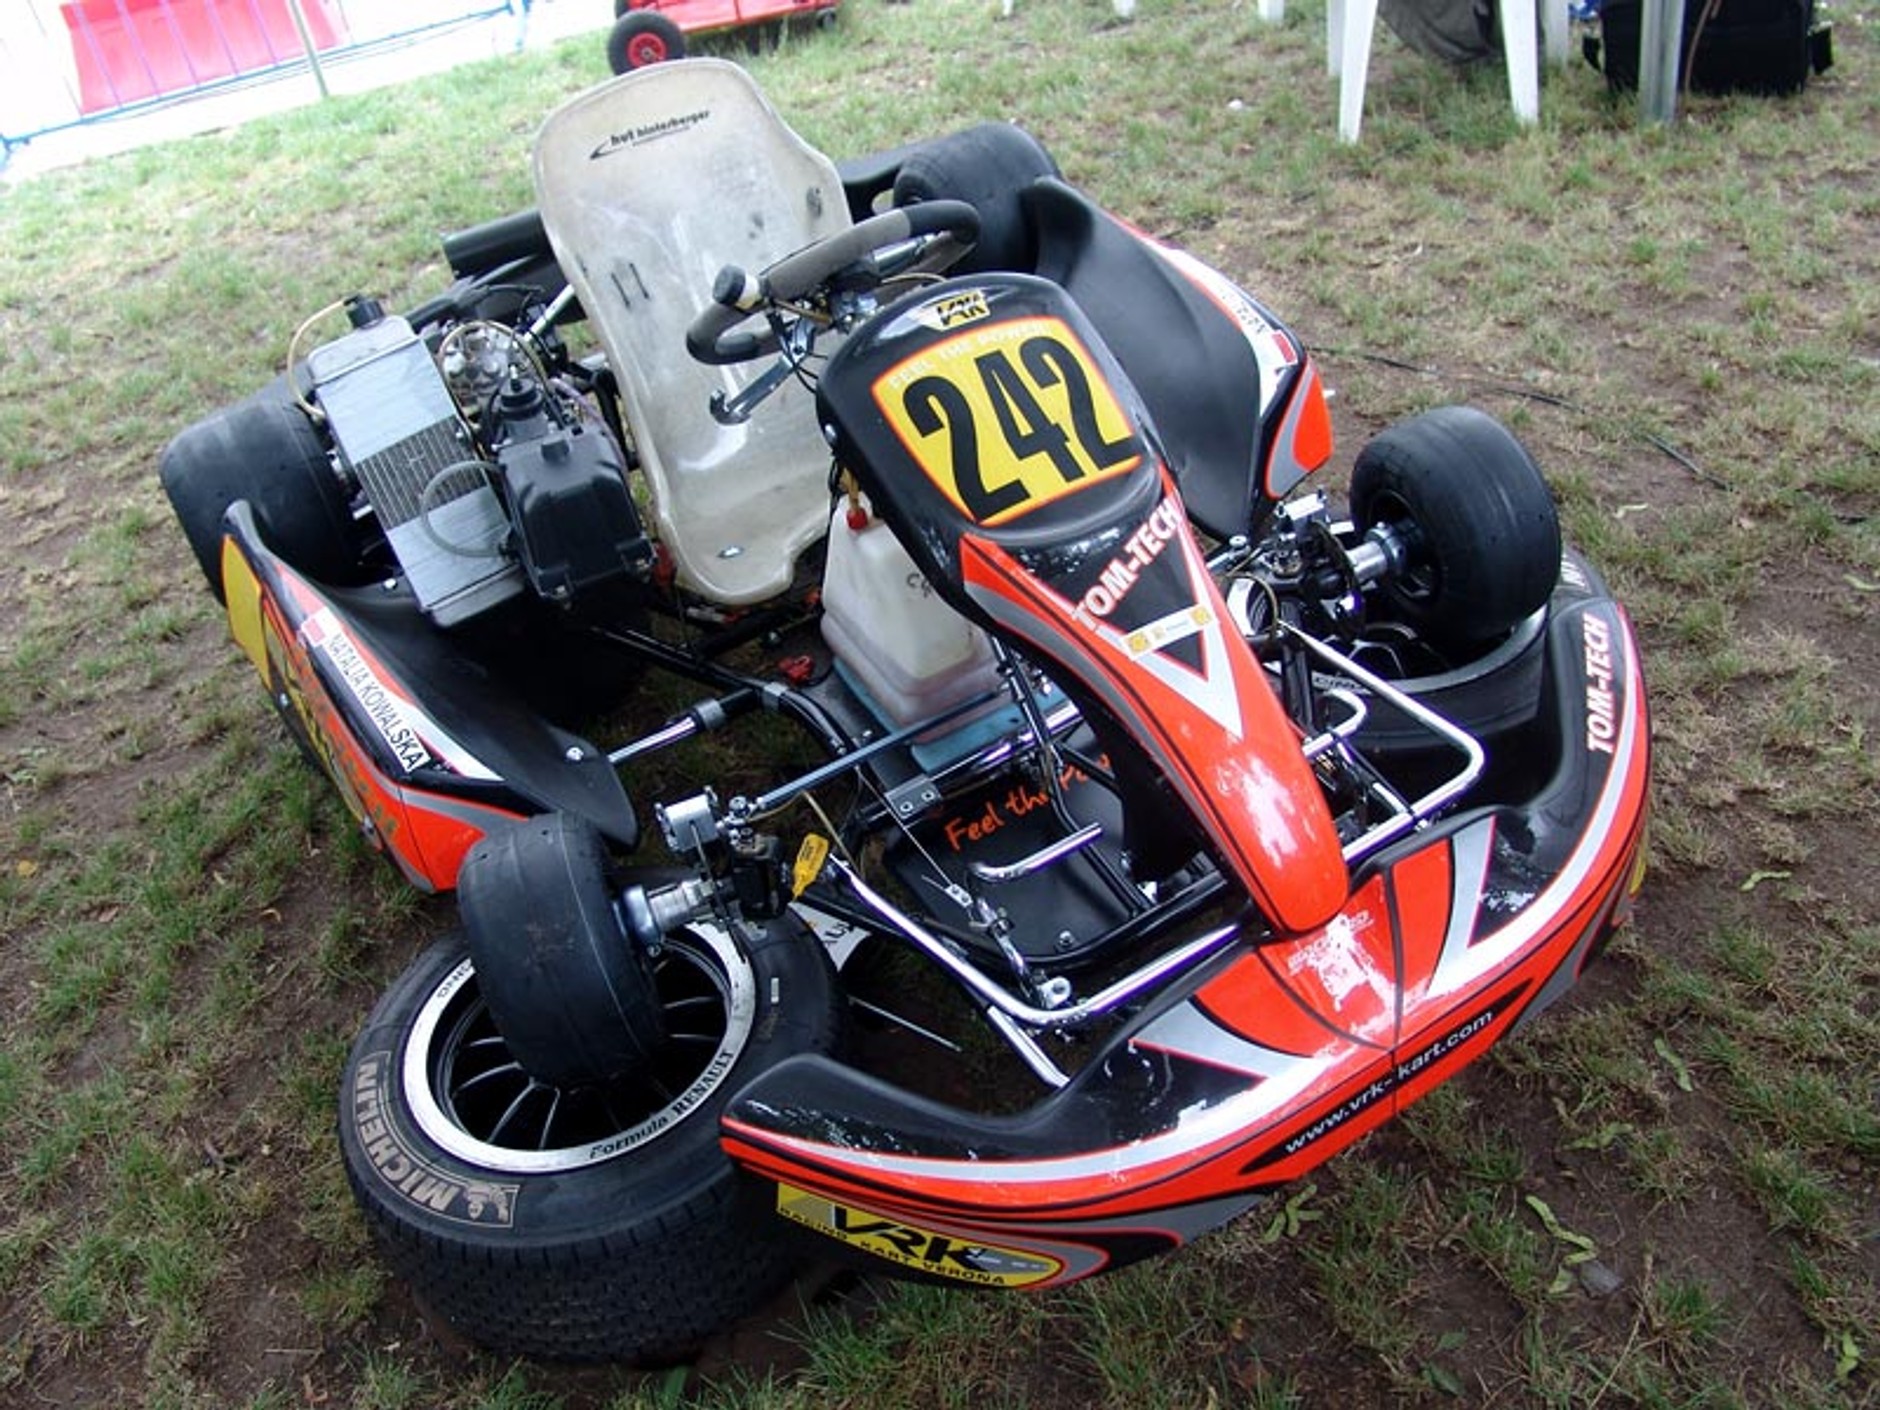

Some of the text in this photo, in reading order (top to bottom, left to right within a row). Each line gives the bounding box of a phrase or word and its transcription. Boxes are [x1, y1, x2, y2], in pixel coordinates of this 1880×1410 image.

[902, 336, 1139, 519] 242
[1072, 497, 1183, 630] TOM-TECH
[329, 633, 370, 686] NATALIA
[360, 681, 424, 770] KOWALSKA
[1583, 612, 1615, 753] TOM-TECH
[944, 800, 1005, 851] Feel
[356, 1062, 460, 1212] MICHELIN
[589, 1049, 734, 1159] Formula RENAULT
[779, 1206, 1005, 1284] RACING KART VERONA
[834, 1206, 989, 1273] VRK
